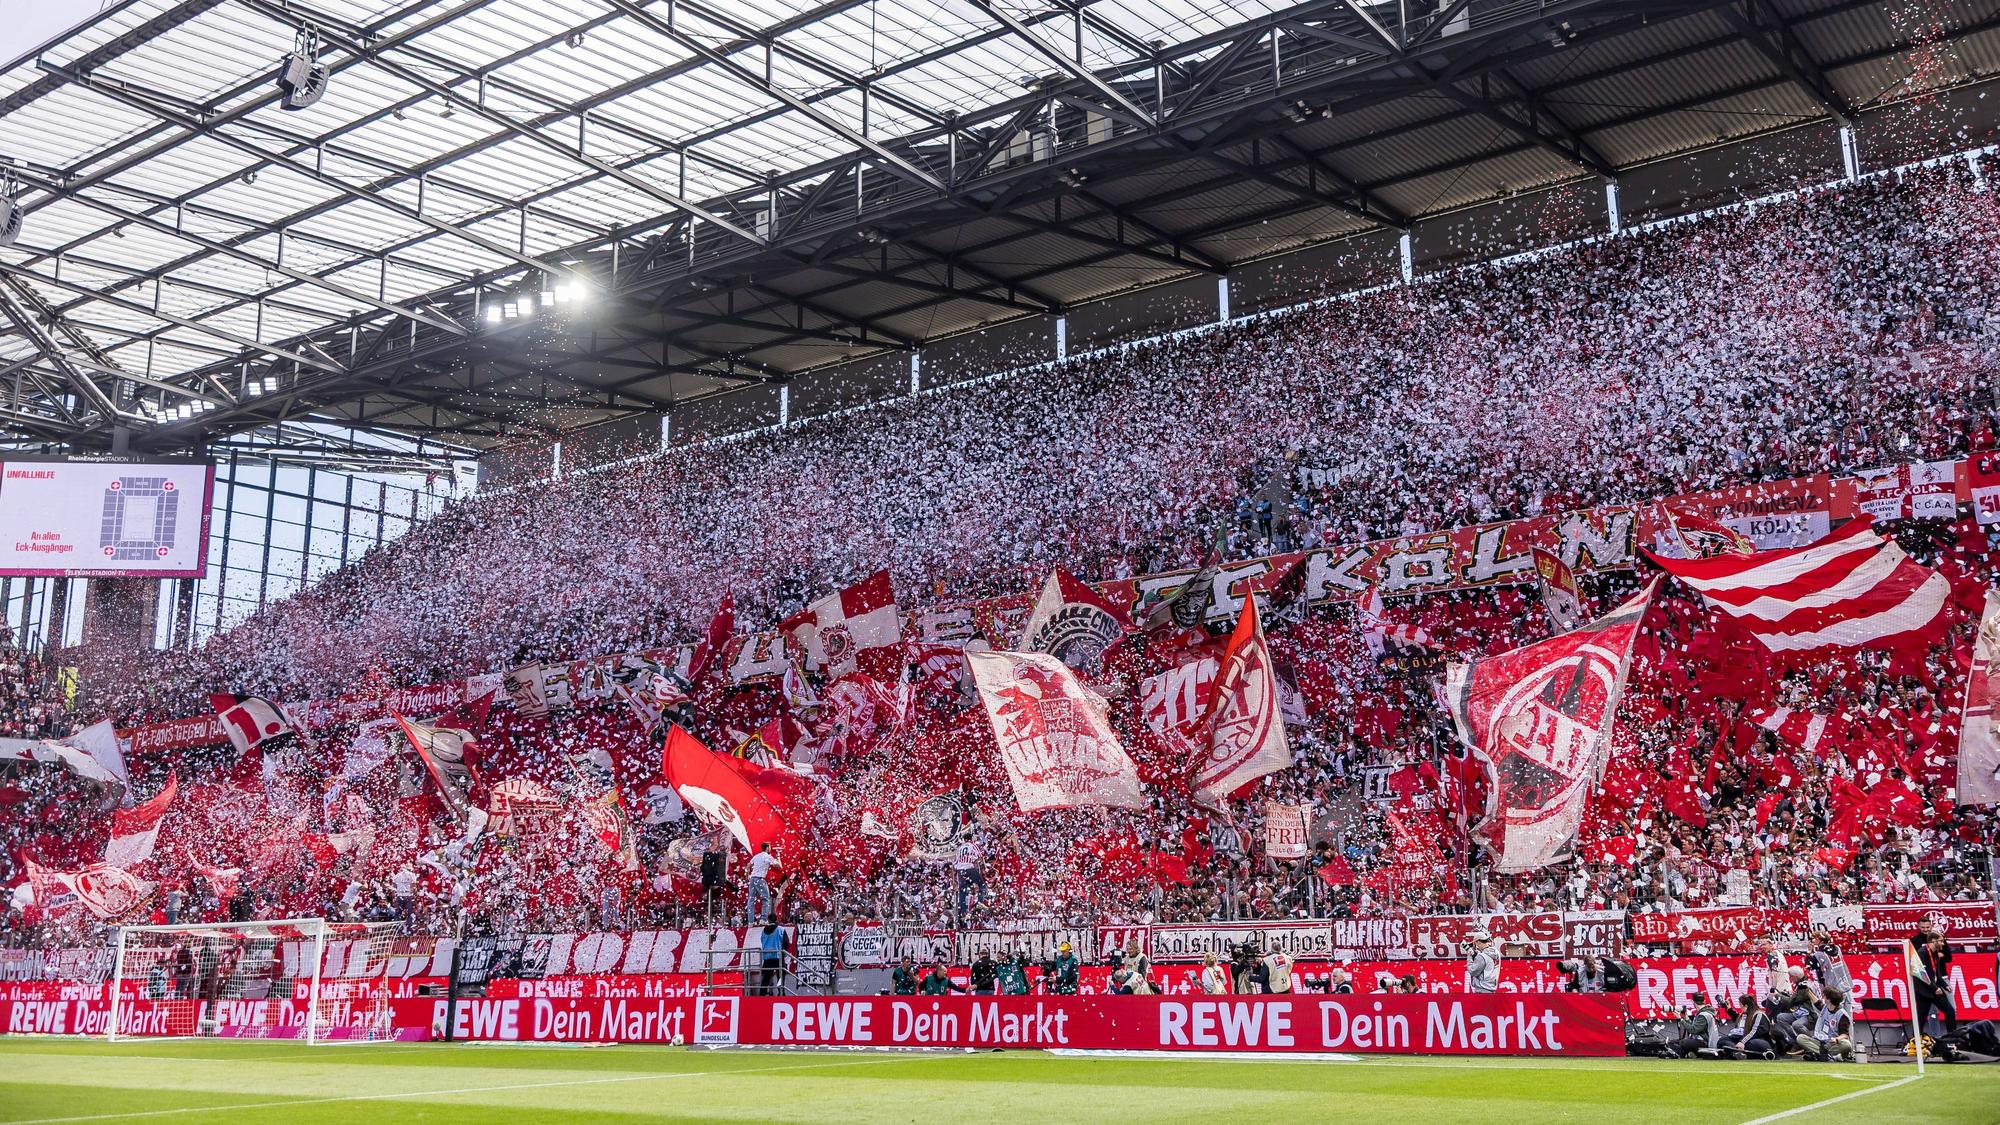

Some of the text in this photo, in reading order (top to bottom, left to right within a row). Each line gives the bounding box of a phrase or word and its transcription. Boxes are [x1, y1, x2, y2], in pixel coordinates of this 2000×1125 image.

[68, 455, 129, 463] RheinEnergieSTADION
[7, 470, 56, 479] UNFALLHILFE
[16, 542, 73, 552] Eck-Ausgängen
[31, 532, 60, 541] An allen
[1306, 511, 1635, 600] KÖLN
[64, 569, 90, 577] TELEKOM
[1334, 920, 1404, 947] RAFIKIS
[1409, 914, 1563, 946] FREAKS
[1634, 915, 1763, 936] RED GOATS
[1953, 913, 1995, 931] Böcke
[852, 938, 882, 950] GEGEN
[1154, 930, 1234, 956] Kölsche
[1574, 923, 1606, 948] FC
[1412, 941, 1563, 957] COLNE
[8, 1001, 169, 1034] REWE Dein Markt
[432, 999, 685, 1040] REWE Dein Markt
[771, 1002, 1069, 1044] REWE Dein Markt
[1159, 1001, 1563, 1050] REWE Dein Markt
